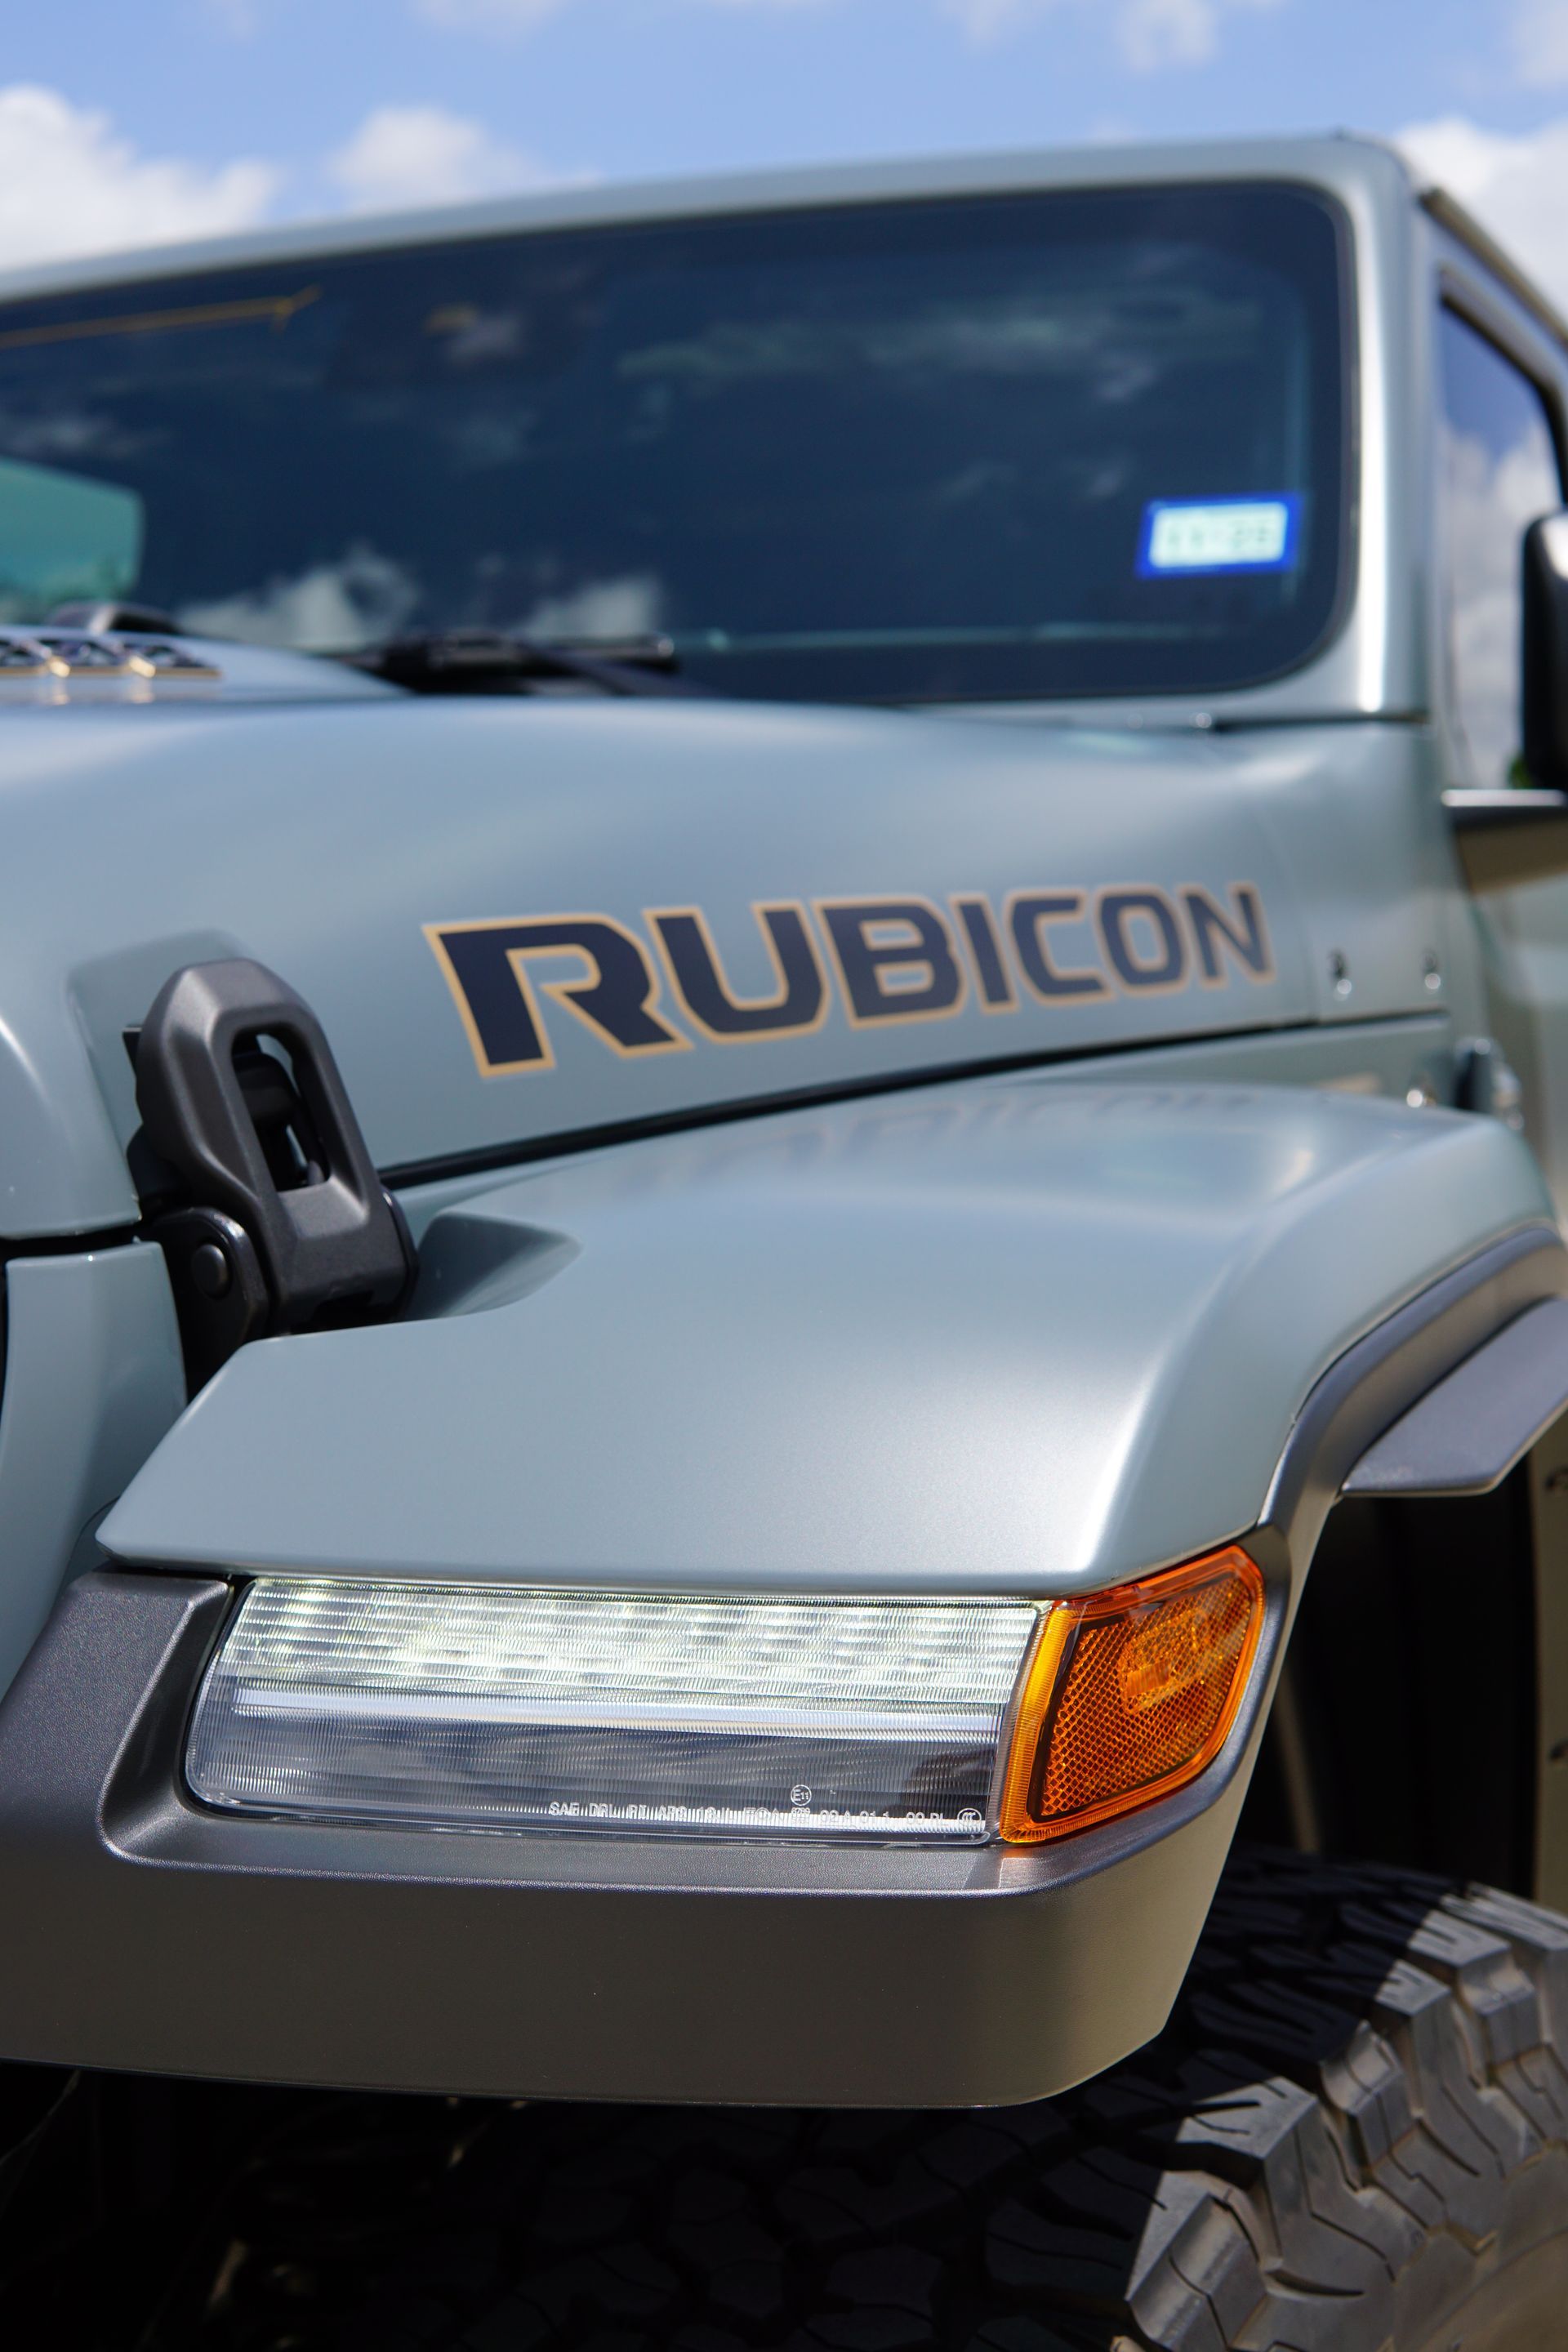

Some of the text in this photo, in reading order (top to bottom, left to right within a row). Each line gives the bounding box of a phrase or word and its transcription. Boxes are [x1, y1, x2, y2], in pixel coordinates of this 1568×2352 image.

[423, 882, 1275, 1077] RUBICON
[550, 1801, 579, 1816] SAE
[589, 1802, 614, 1818] DRL
